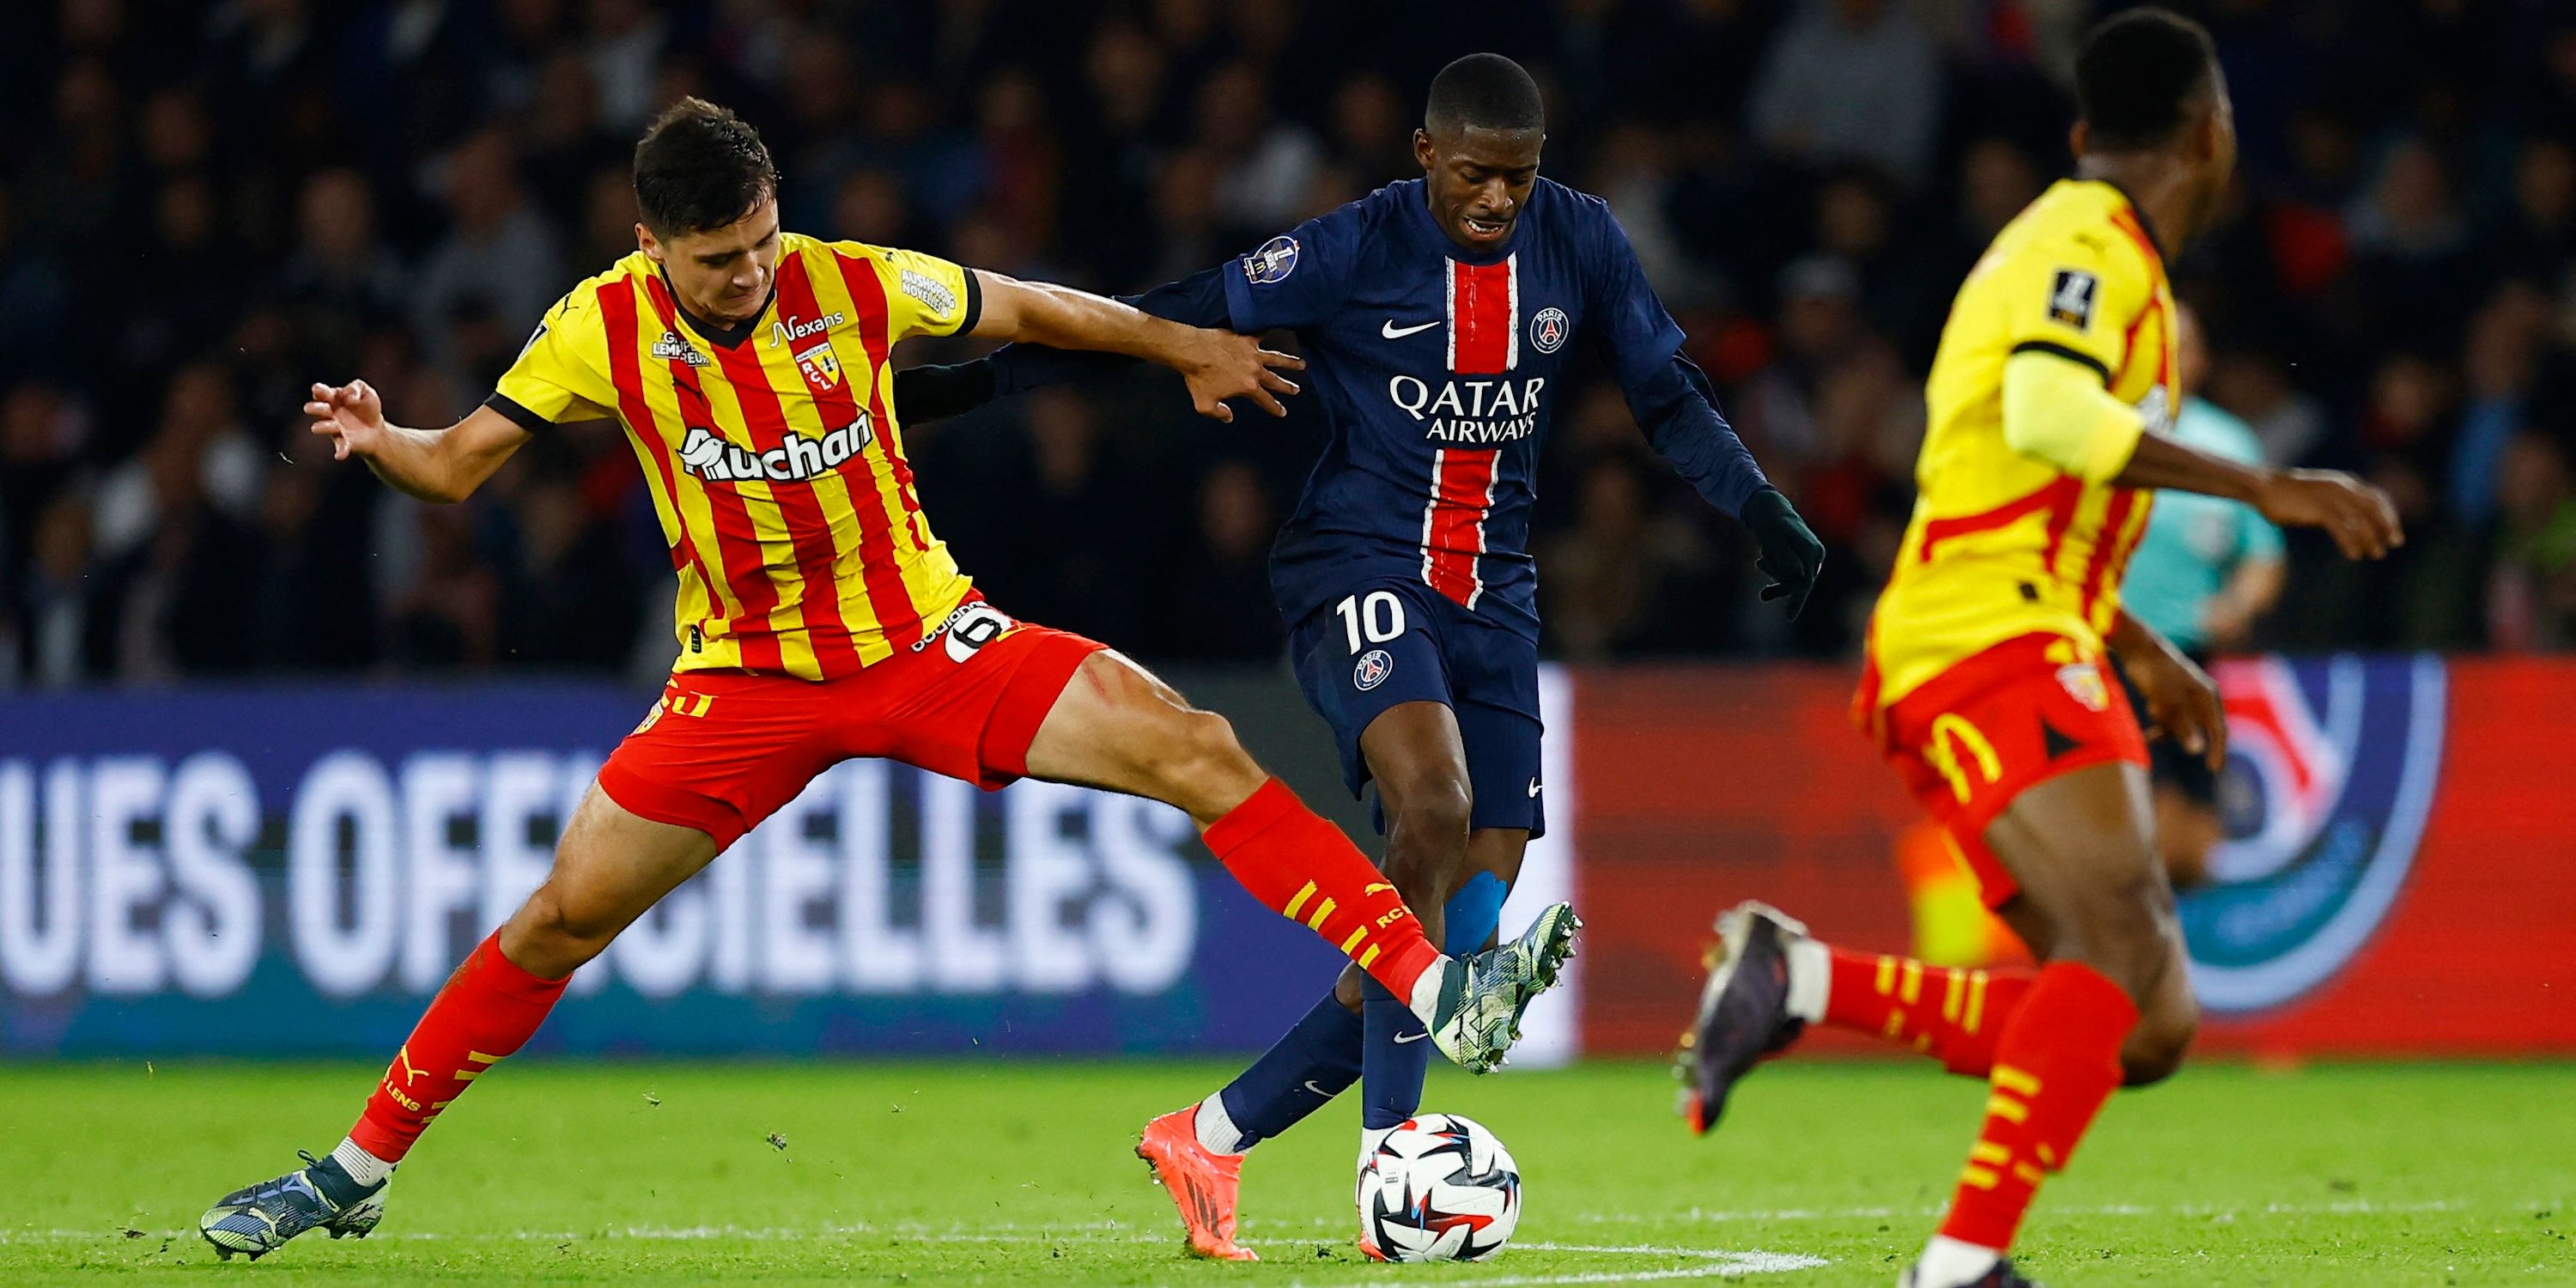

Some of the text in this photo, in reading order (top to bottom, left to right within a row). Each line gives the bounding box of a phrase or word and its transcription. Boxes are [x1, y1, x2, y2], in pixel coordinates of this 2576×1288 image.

[770, 312, 845, 348] Nexans
[1537, 310, 1564, 323] PARIS
[801, 361, 832, 392] RCL
[1389, 374, 1545, 421] QATAR
[1426, 411, 1536, 443] AIRWAYS
[677, 414, 872, 481] Auchan
[1336, 591, 1406, 655] 10
[386, 1079, 422, 1112] LENS
